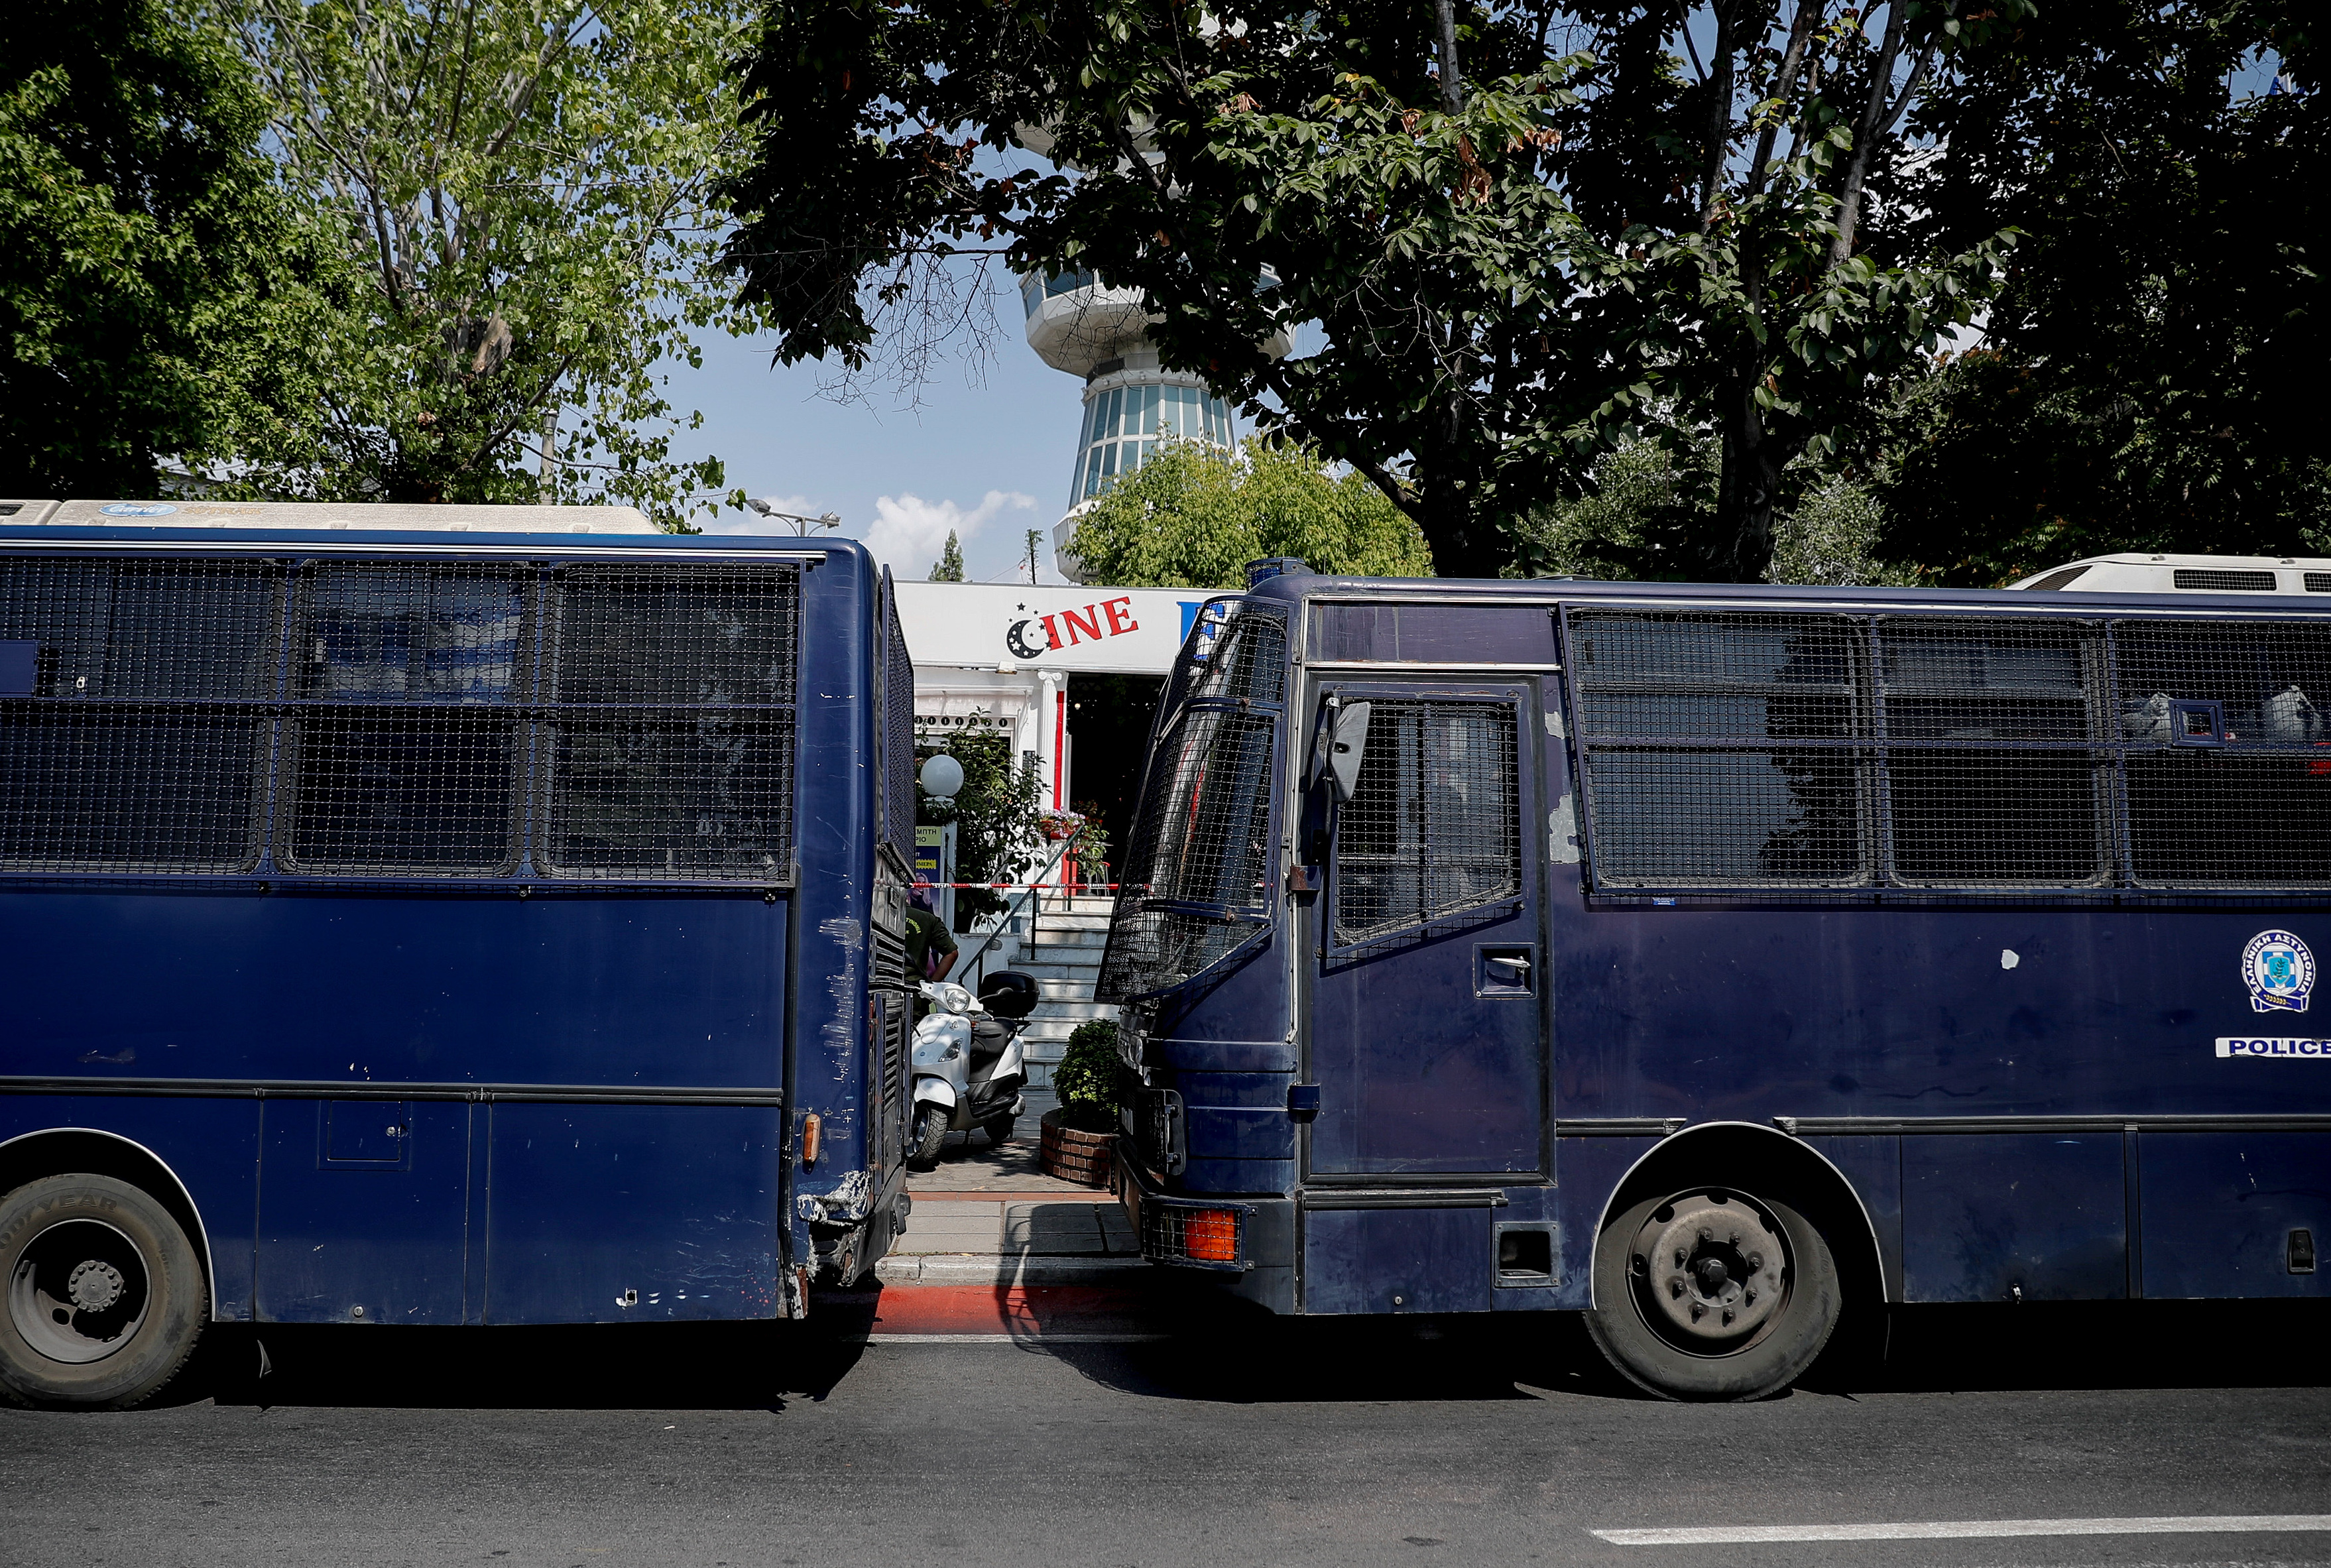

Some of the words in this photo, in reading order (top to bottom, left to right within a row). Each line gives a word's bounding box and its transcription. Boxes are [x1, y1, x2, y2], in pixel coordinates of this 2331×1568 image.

[906, 917, 922, 934] ΤΥΝΟΜΙΑ
[2245, 934, 2272, 993] ΕΛΛΗΝΙΚΗ
[2274, 934, 2313, 993] ΑΣΤΥΝΟΜΙΑ
